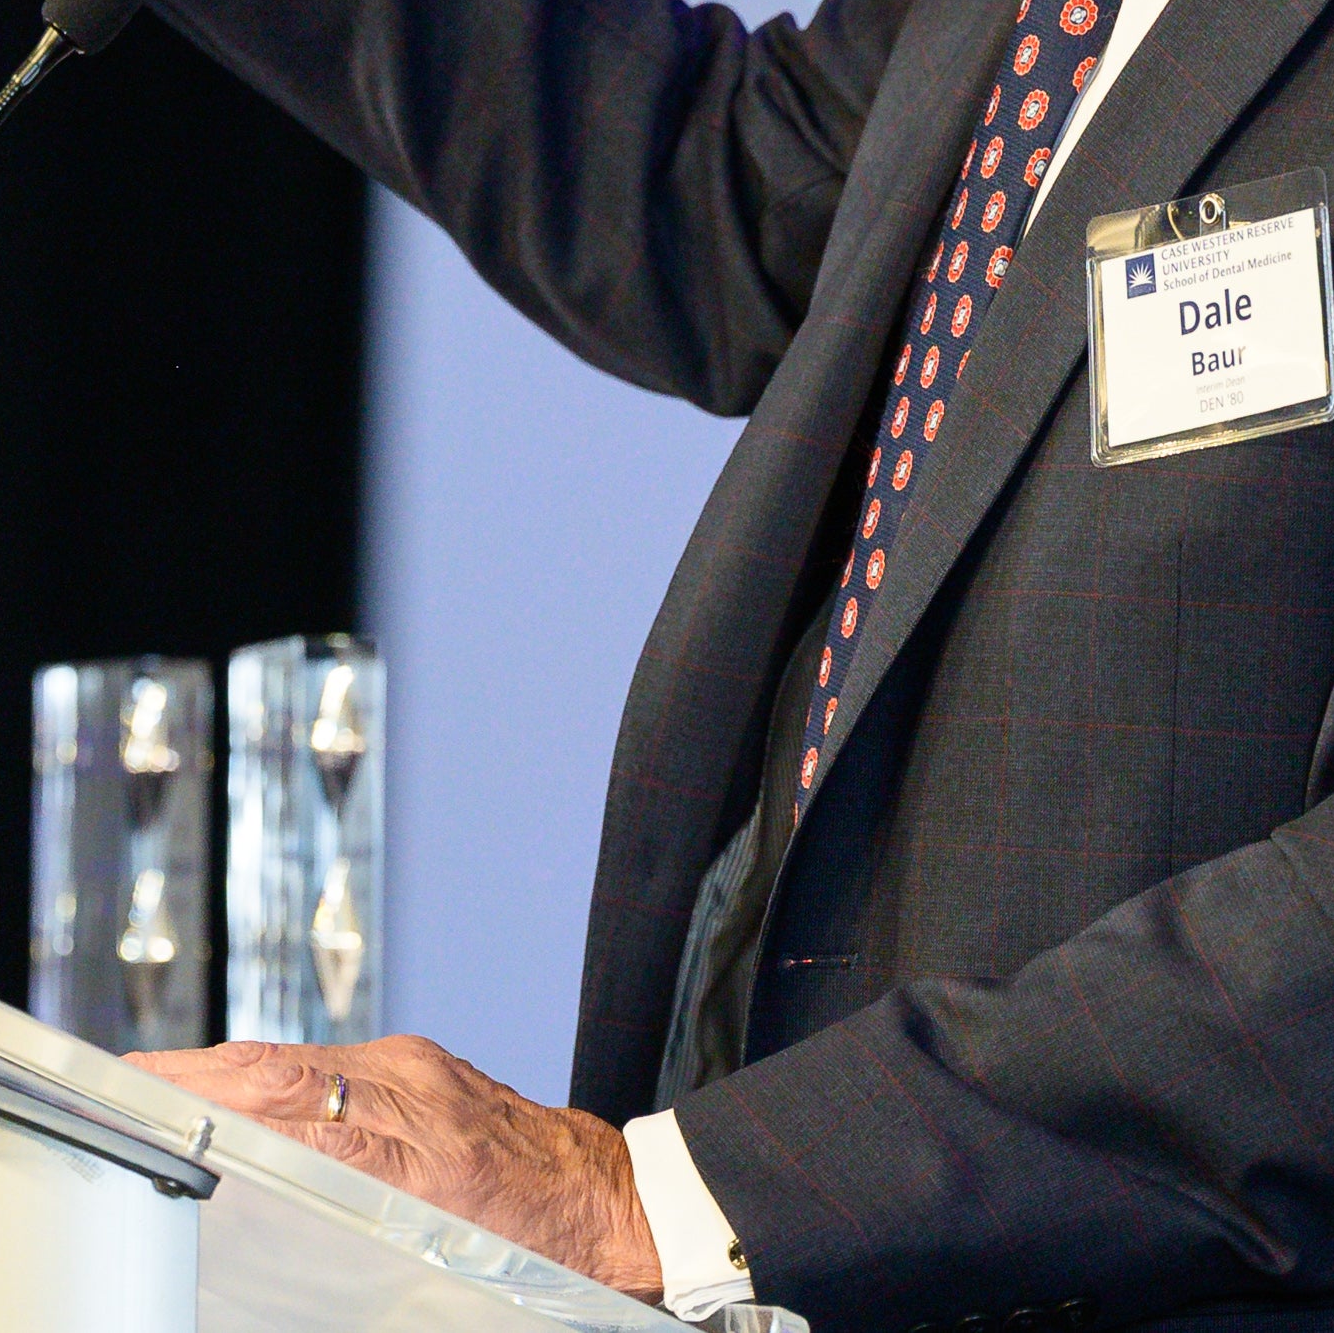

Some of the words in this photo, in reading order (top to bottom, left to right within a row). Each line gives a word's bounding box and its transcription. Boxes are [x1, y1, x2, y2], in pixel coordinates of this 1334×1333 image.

[1161, 244, 1189, 261] CASE
[1191, 230, 1244, 253] WESTERN
[1247, 217, 1294, 238] RESERVE
[1162, 250, 1230, 275] UNIVERSITY
[1163, 273, 1197, 291] School
[1199, 270, 1210, 283] of
[1212, 261, 1245, 279] Dental
[1247, 251, 1292, 270] Medicine
[1179, 288, 1252, 336] Dale
[1191, 345, 1246, 376] Baur
[1199, 396, 1224, 413] DEN
